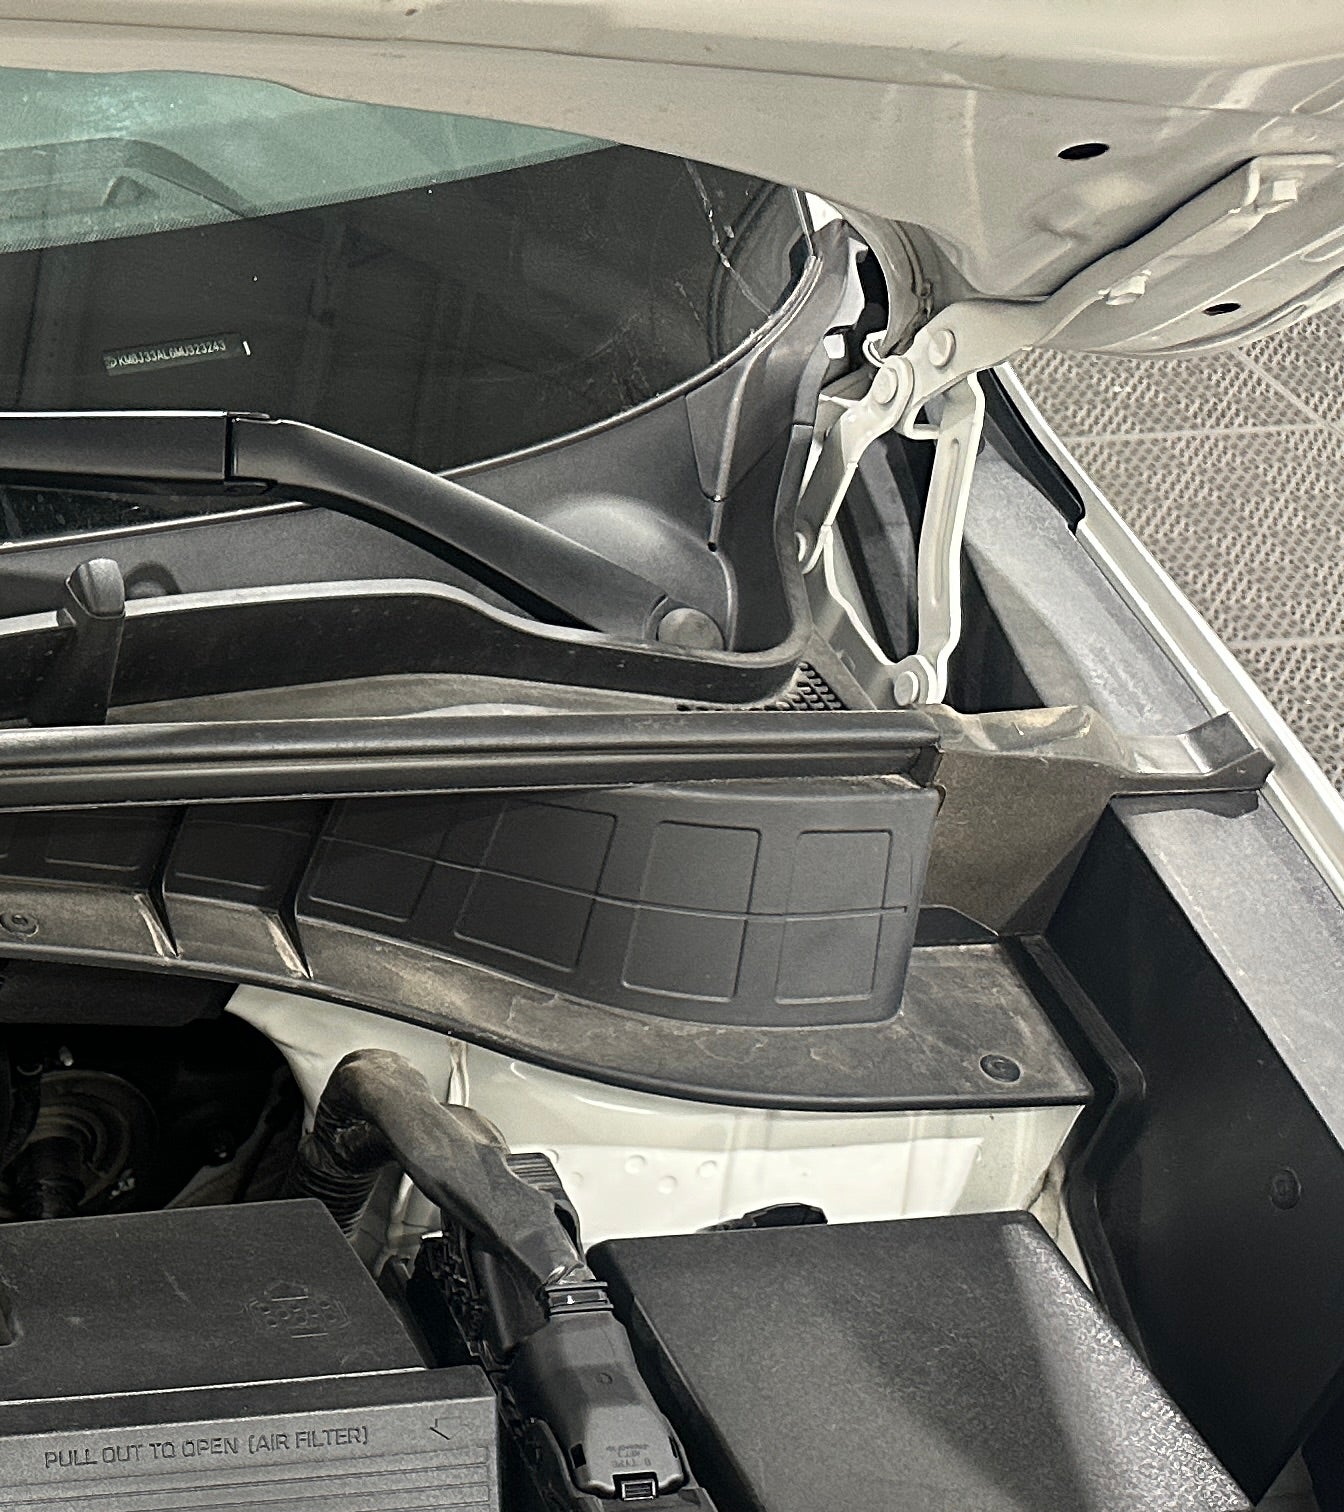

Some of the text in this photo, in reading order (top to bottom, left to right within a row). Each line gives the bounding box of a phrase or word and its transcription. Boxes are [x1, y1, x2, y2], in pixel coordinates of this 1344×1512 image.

[44, 1449, 97, 1469] PULL
[102, 1444, 141, 1463] OUT
[149, 1440, 176, 1460] TO
[181, 1436, 238, 1458] OPEN
